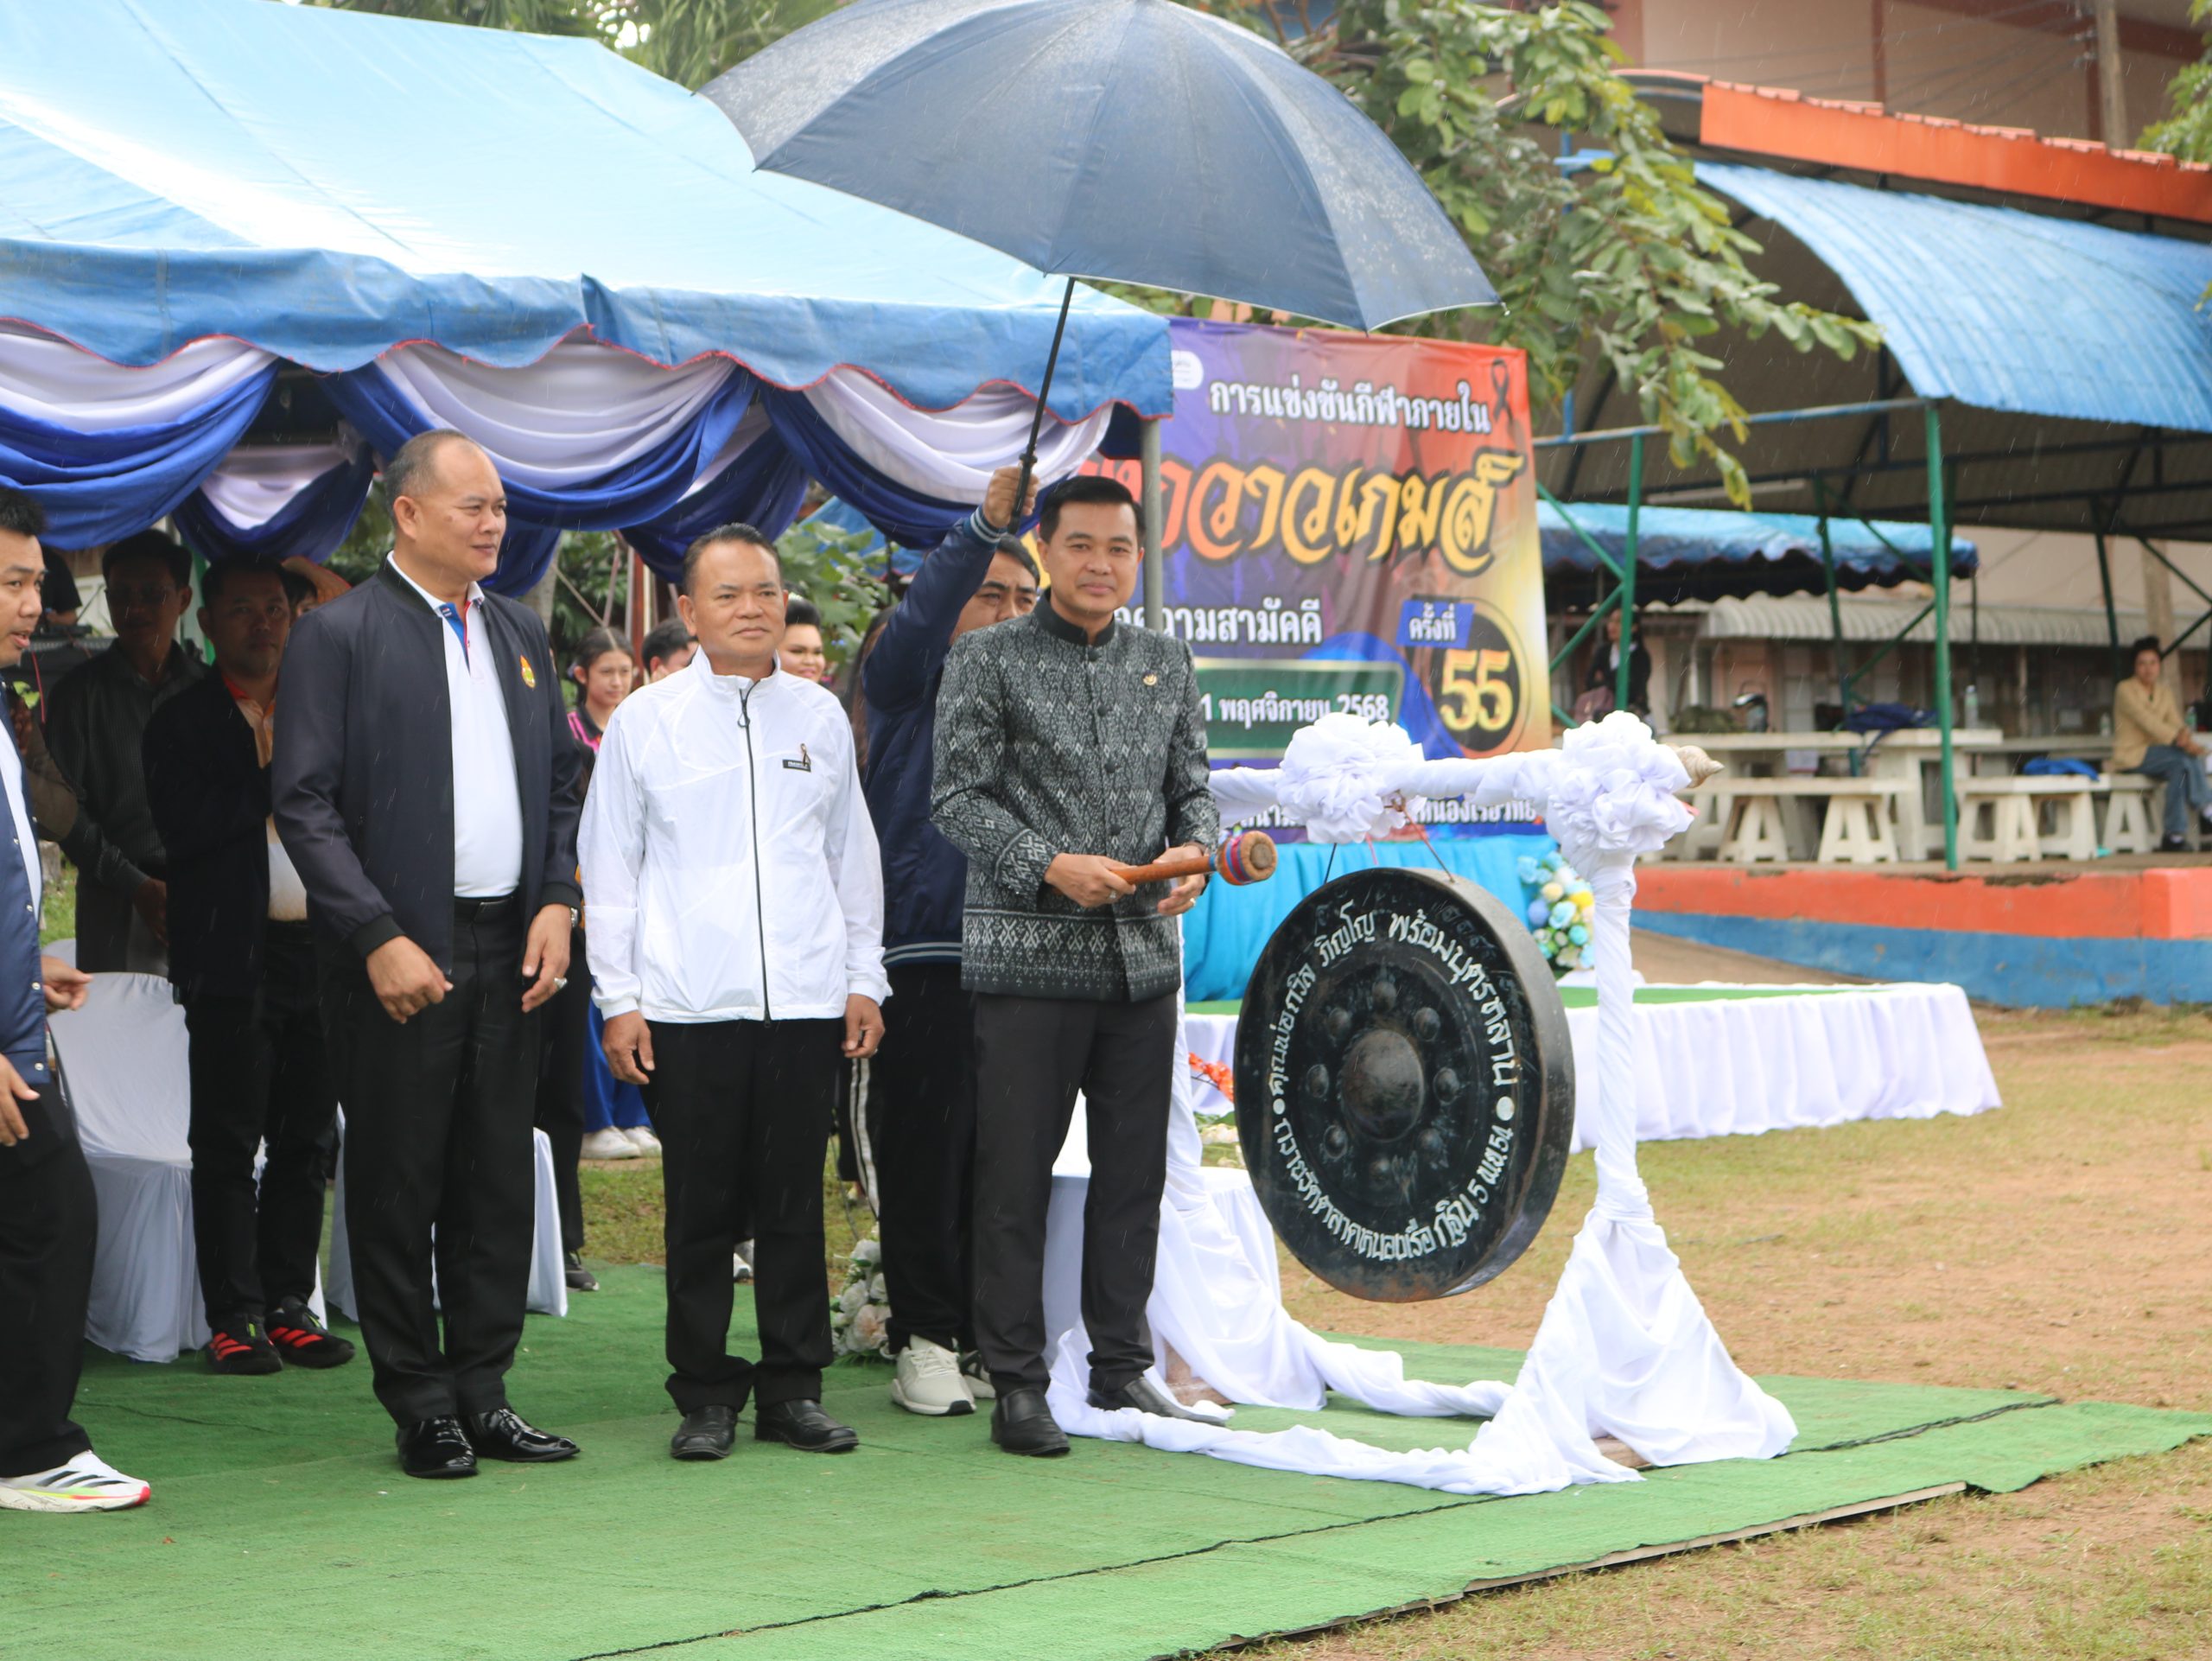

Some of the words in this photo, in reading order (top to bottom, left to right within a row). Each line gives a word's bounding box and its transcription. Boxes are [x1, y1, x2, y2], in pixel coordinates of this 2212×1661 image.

[1210, 374, 1491, 433] การแข่งขันกีฬาภายใน
[1408, 601, 1457, 642] ครั้งที่
[1218, 690, 1332, 729] พฤศจิกายน
[1337, 693, 1390, 722] 2568
[1439, 648, 1514, 732] 55
[1313, 898, 1376, 968] ภิญโญ
[1388, 907, 1519, 1087] พร้อมบุตรหลาน
[1467, 1177, 1490, 1205] 5
